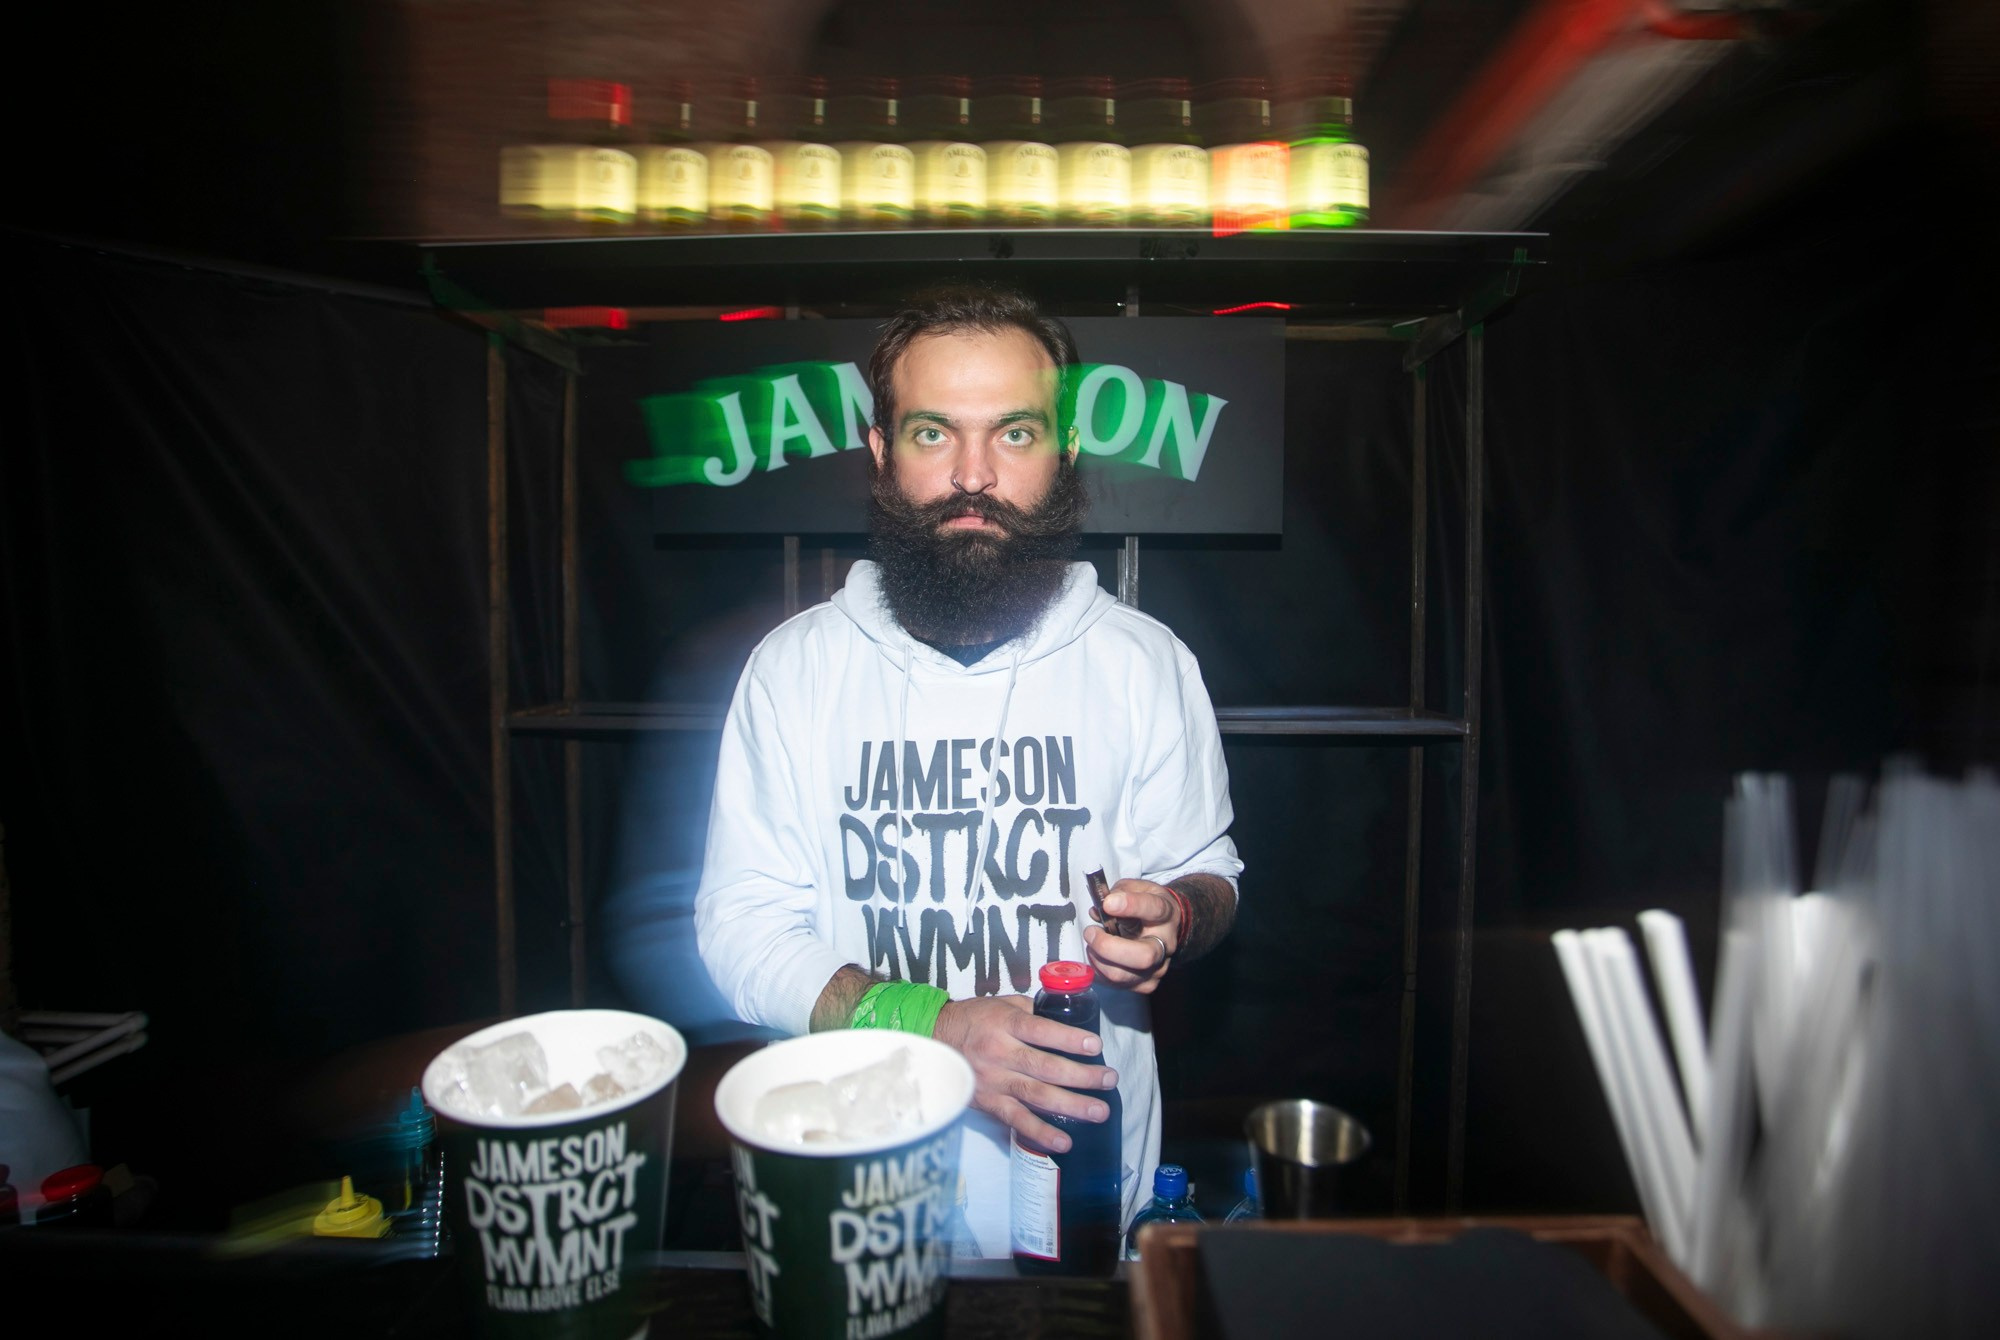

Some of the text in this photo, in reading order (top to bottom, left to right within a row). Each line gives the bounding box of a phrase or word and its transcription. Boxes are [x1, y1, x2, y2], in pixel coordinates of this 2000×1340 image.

[703, 361, 1229, 487] JAMON
[844, 736, 1077, 811] JAMESON
[839, 807, 1092, 904] DSTRCT
[861, 901, 1077, 997] MVMNT
[470, 1121, 628, 1183] JAMESON
[841, 1138, 947, 1209] JAMES
[464, 1152, 647, 1237] DSTRCT
[829, 1185, 947, 1264] DSTR
[479, 1211, 638, 1287] MVMNT
[586, 1268, 621, 1302] ELSE
[845, 1234, 946, 1315] MVM
